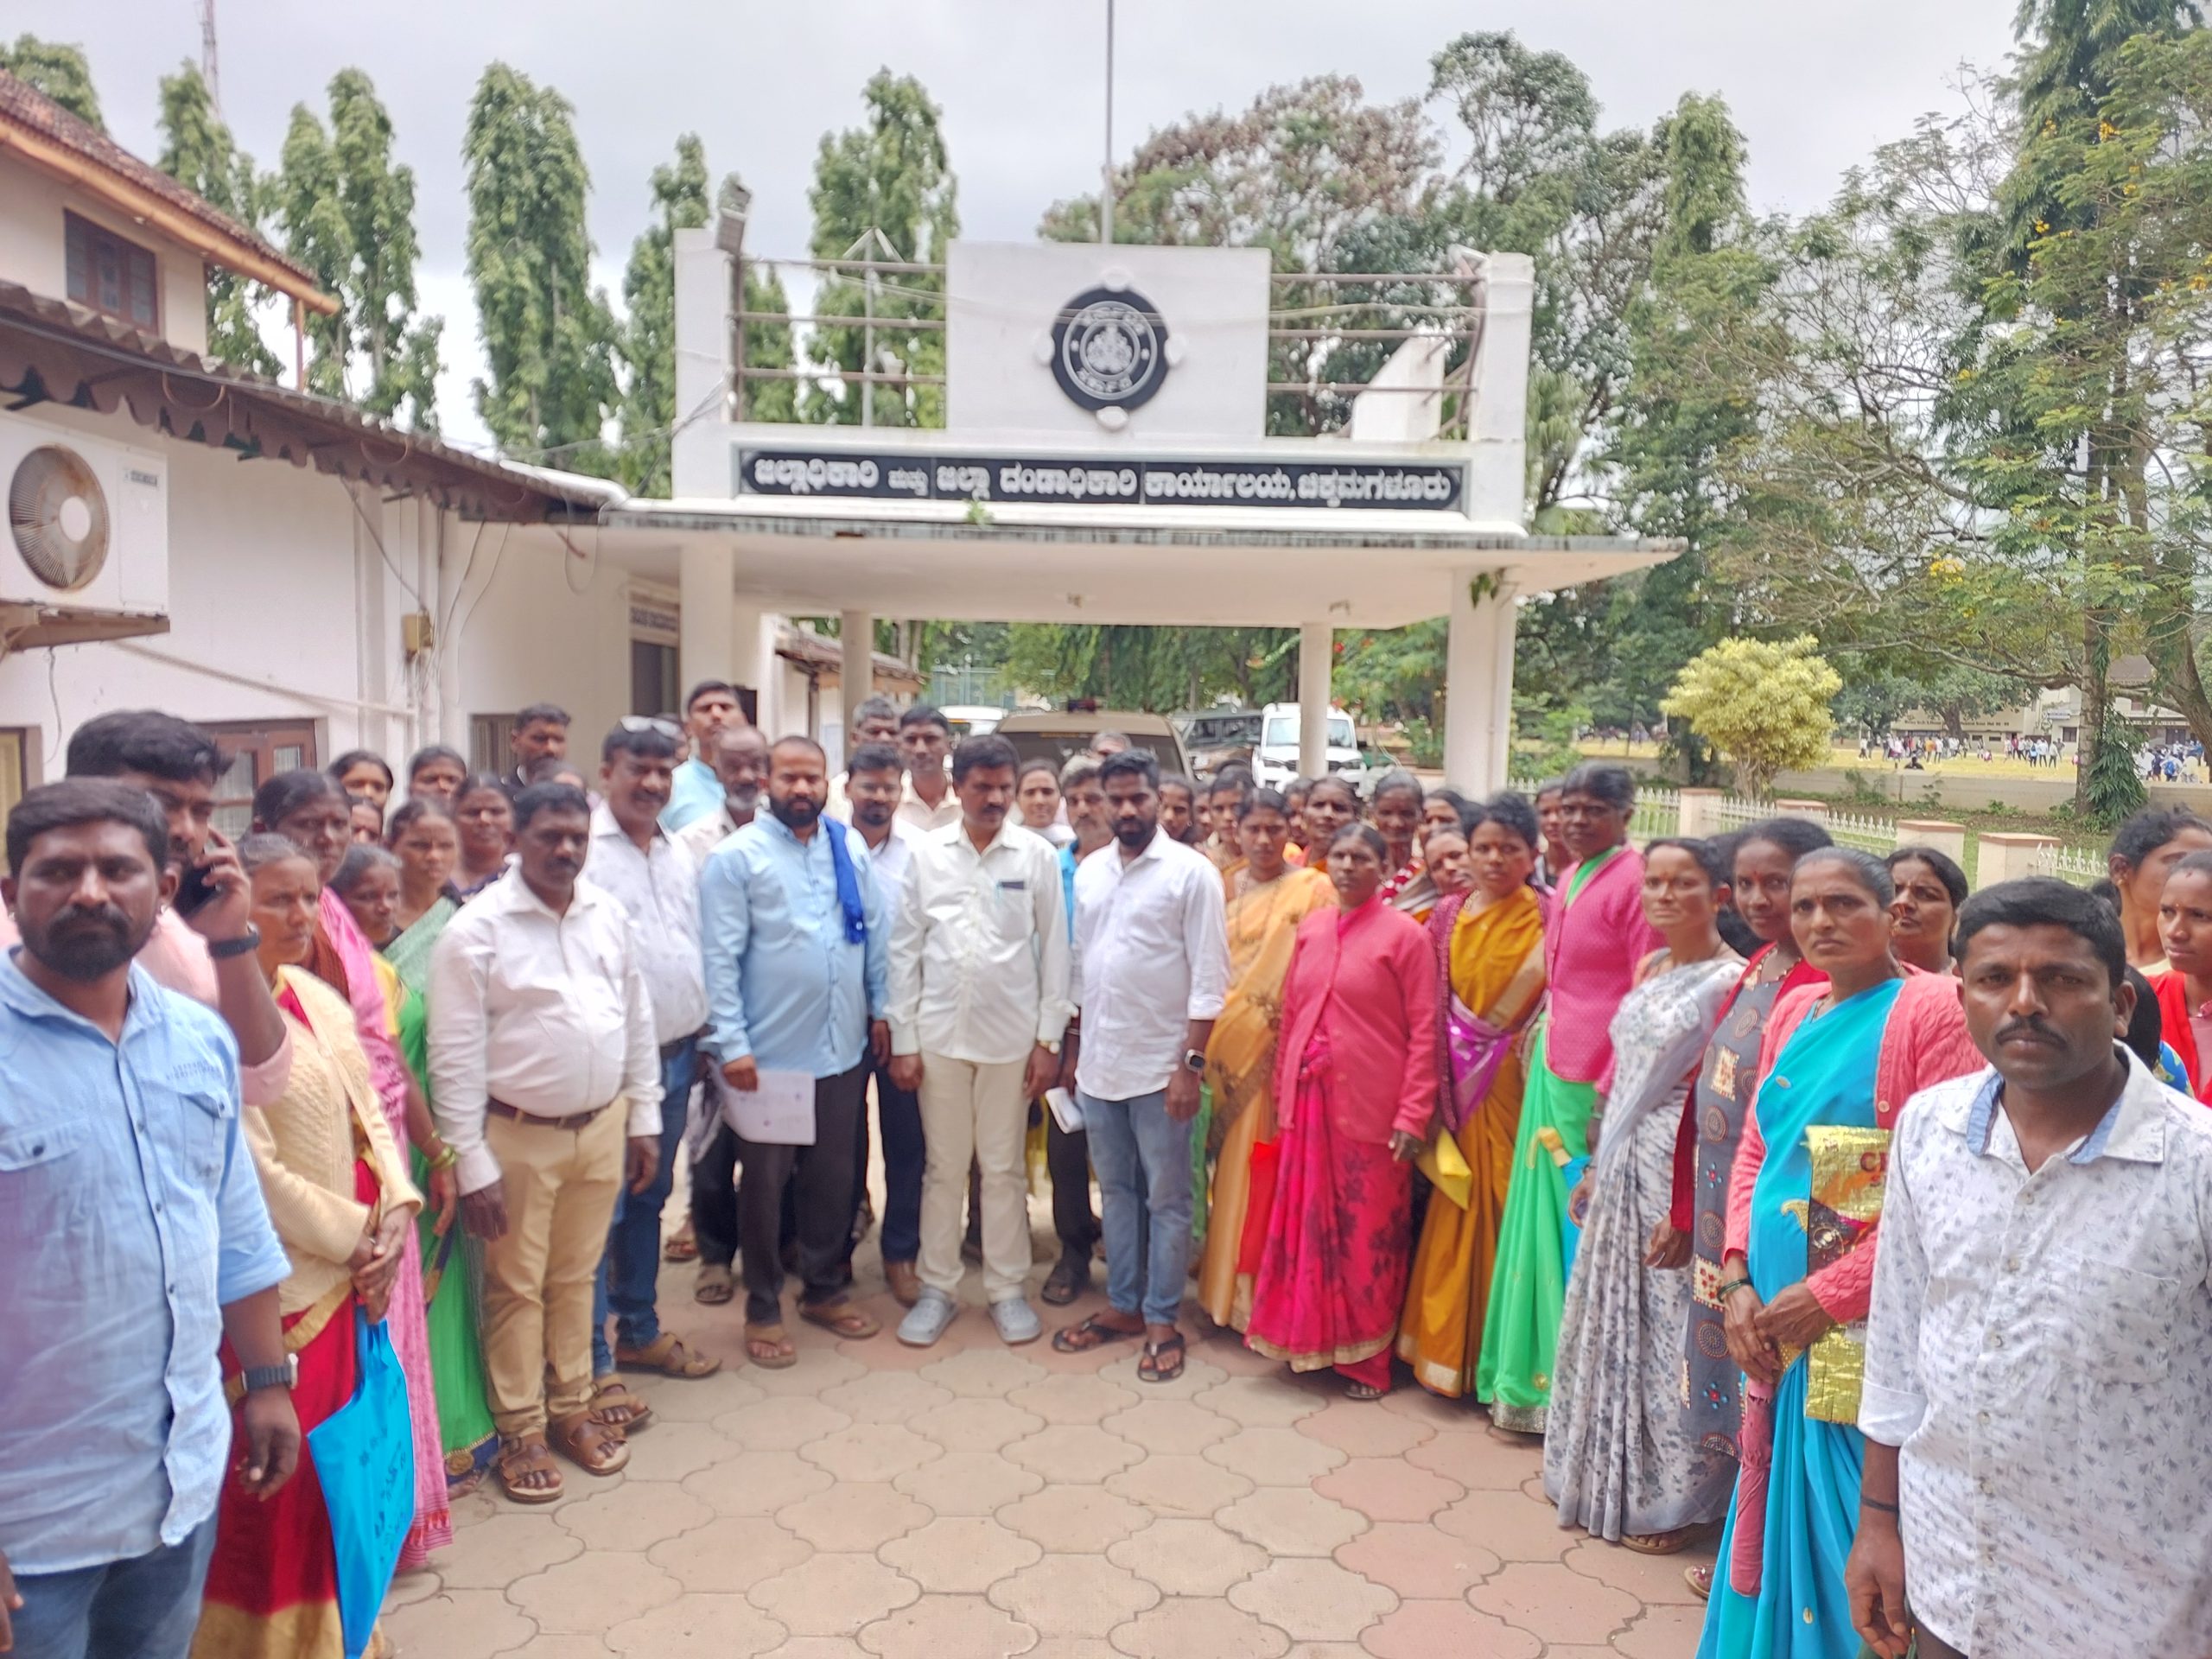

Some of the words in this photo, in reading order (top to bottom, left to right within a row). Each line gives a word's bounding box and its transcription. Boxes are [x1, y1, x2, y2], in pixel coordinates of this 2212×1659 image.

[887, 467, 929, 496] ಮತ್ತು
[937, 465, 990, 500] ಜಿಲ್ಲಾ
[1000, 461, 1137, 499] ದಂಡಾಧಿಕಾರಿ
